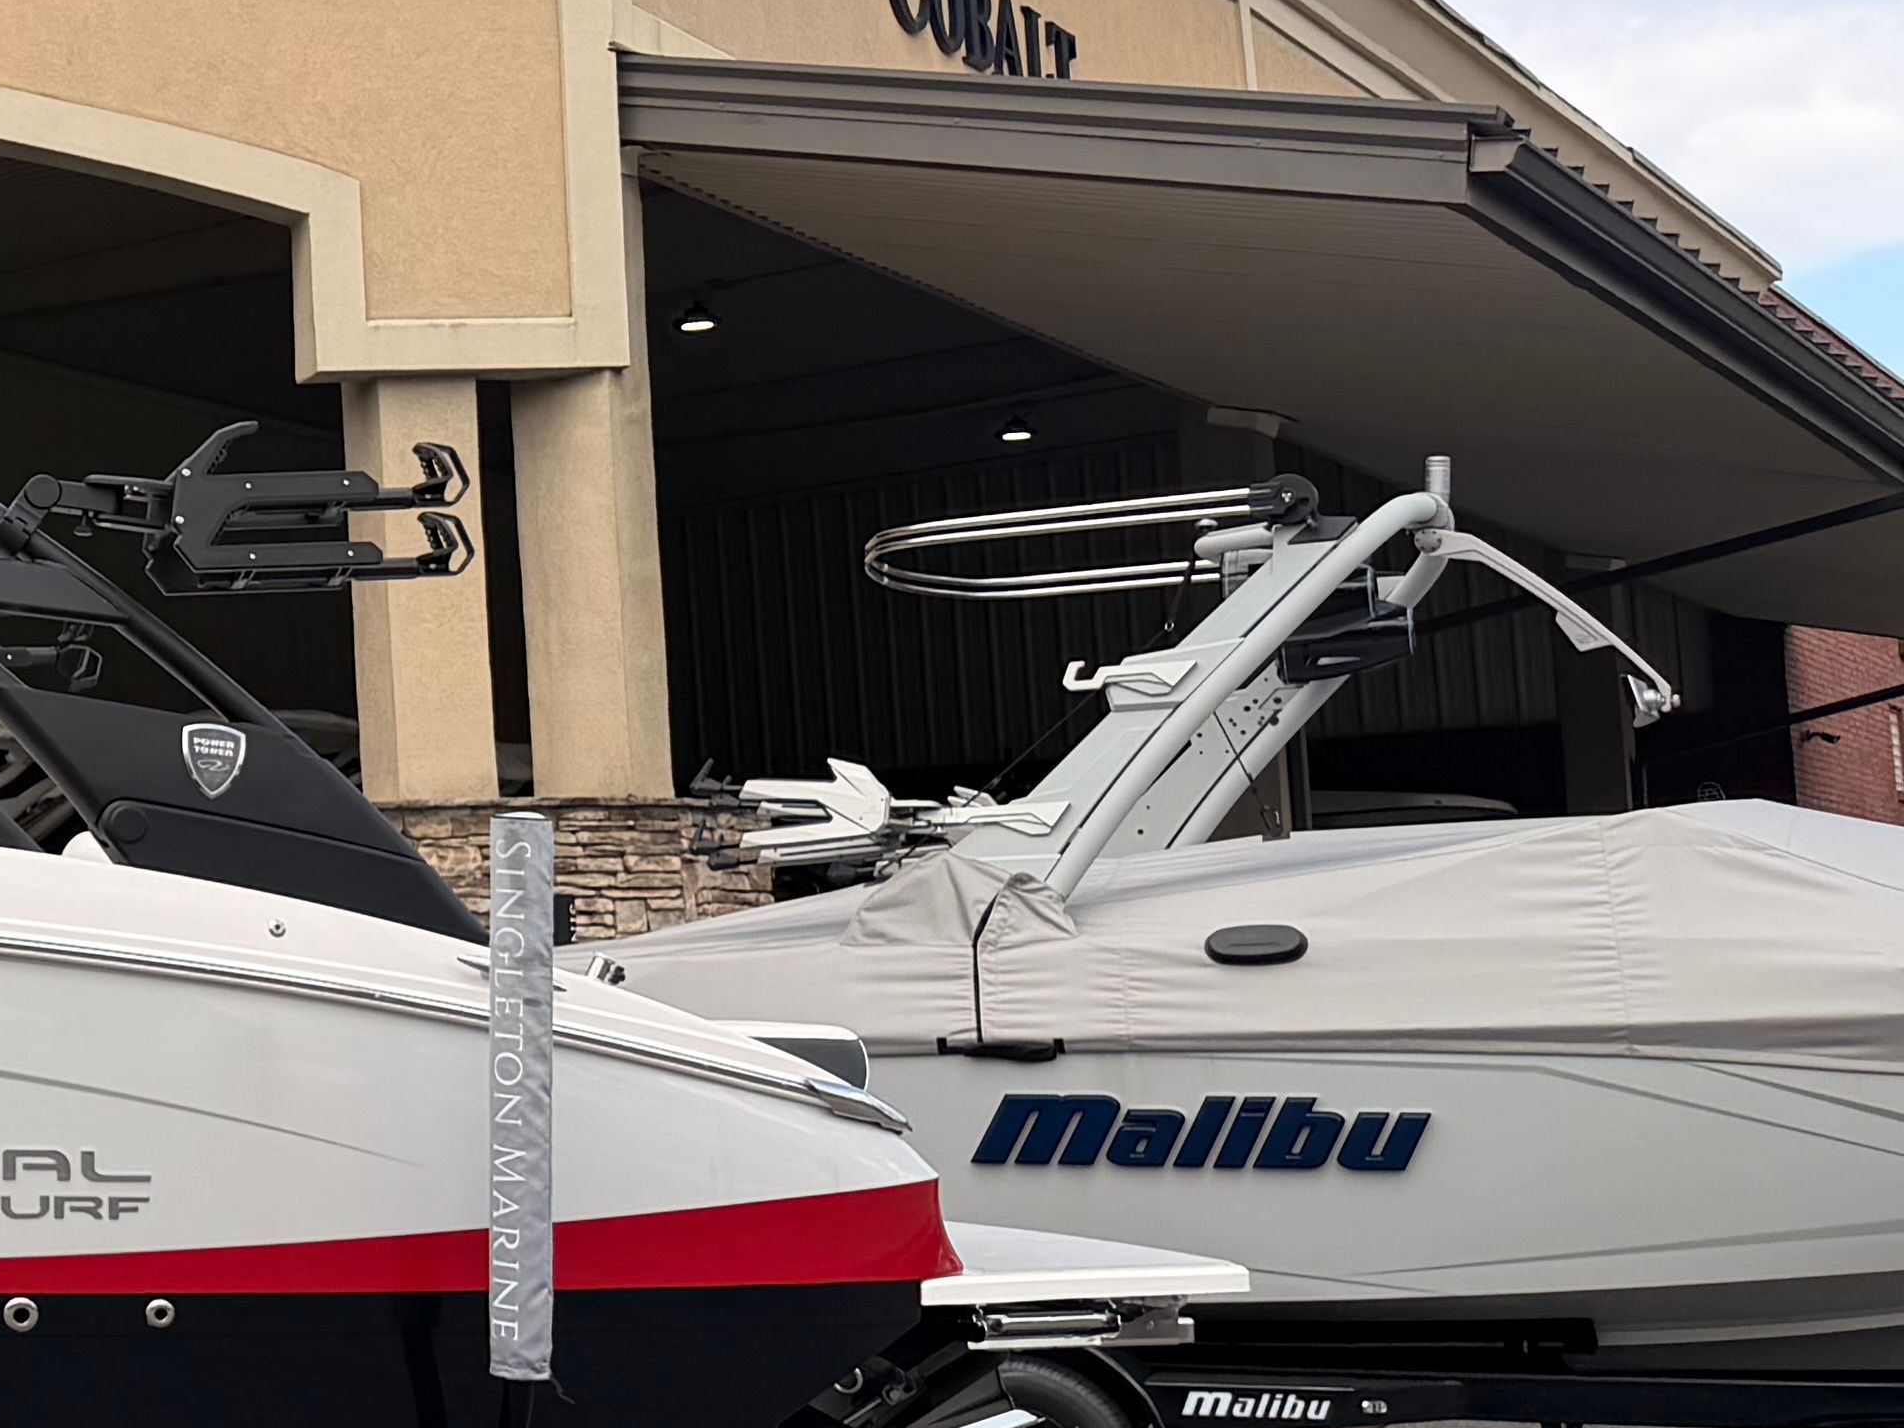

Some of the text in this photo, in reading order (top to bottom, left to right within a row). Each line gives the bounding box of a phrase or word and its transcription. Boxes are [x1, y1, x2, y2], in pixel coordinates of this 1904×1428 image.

[492, 838, 531, 1341] SINGLETON MARINE
[970, 1093, 1432, 1175] Malibu
[1181, 1390, 1331, 1420] Malibu
